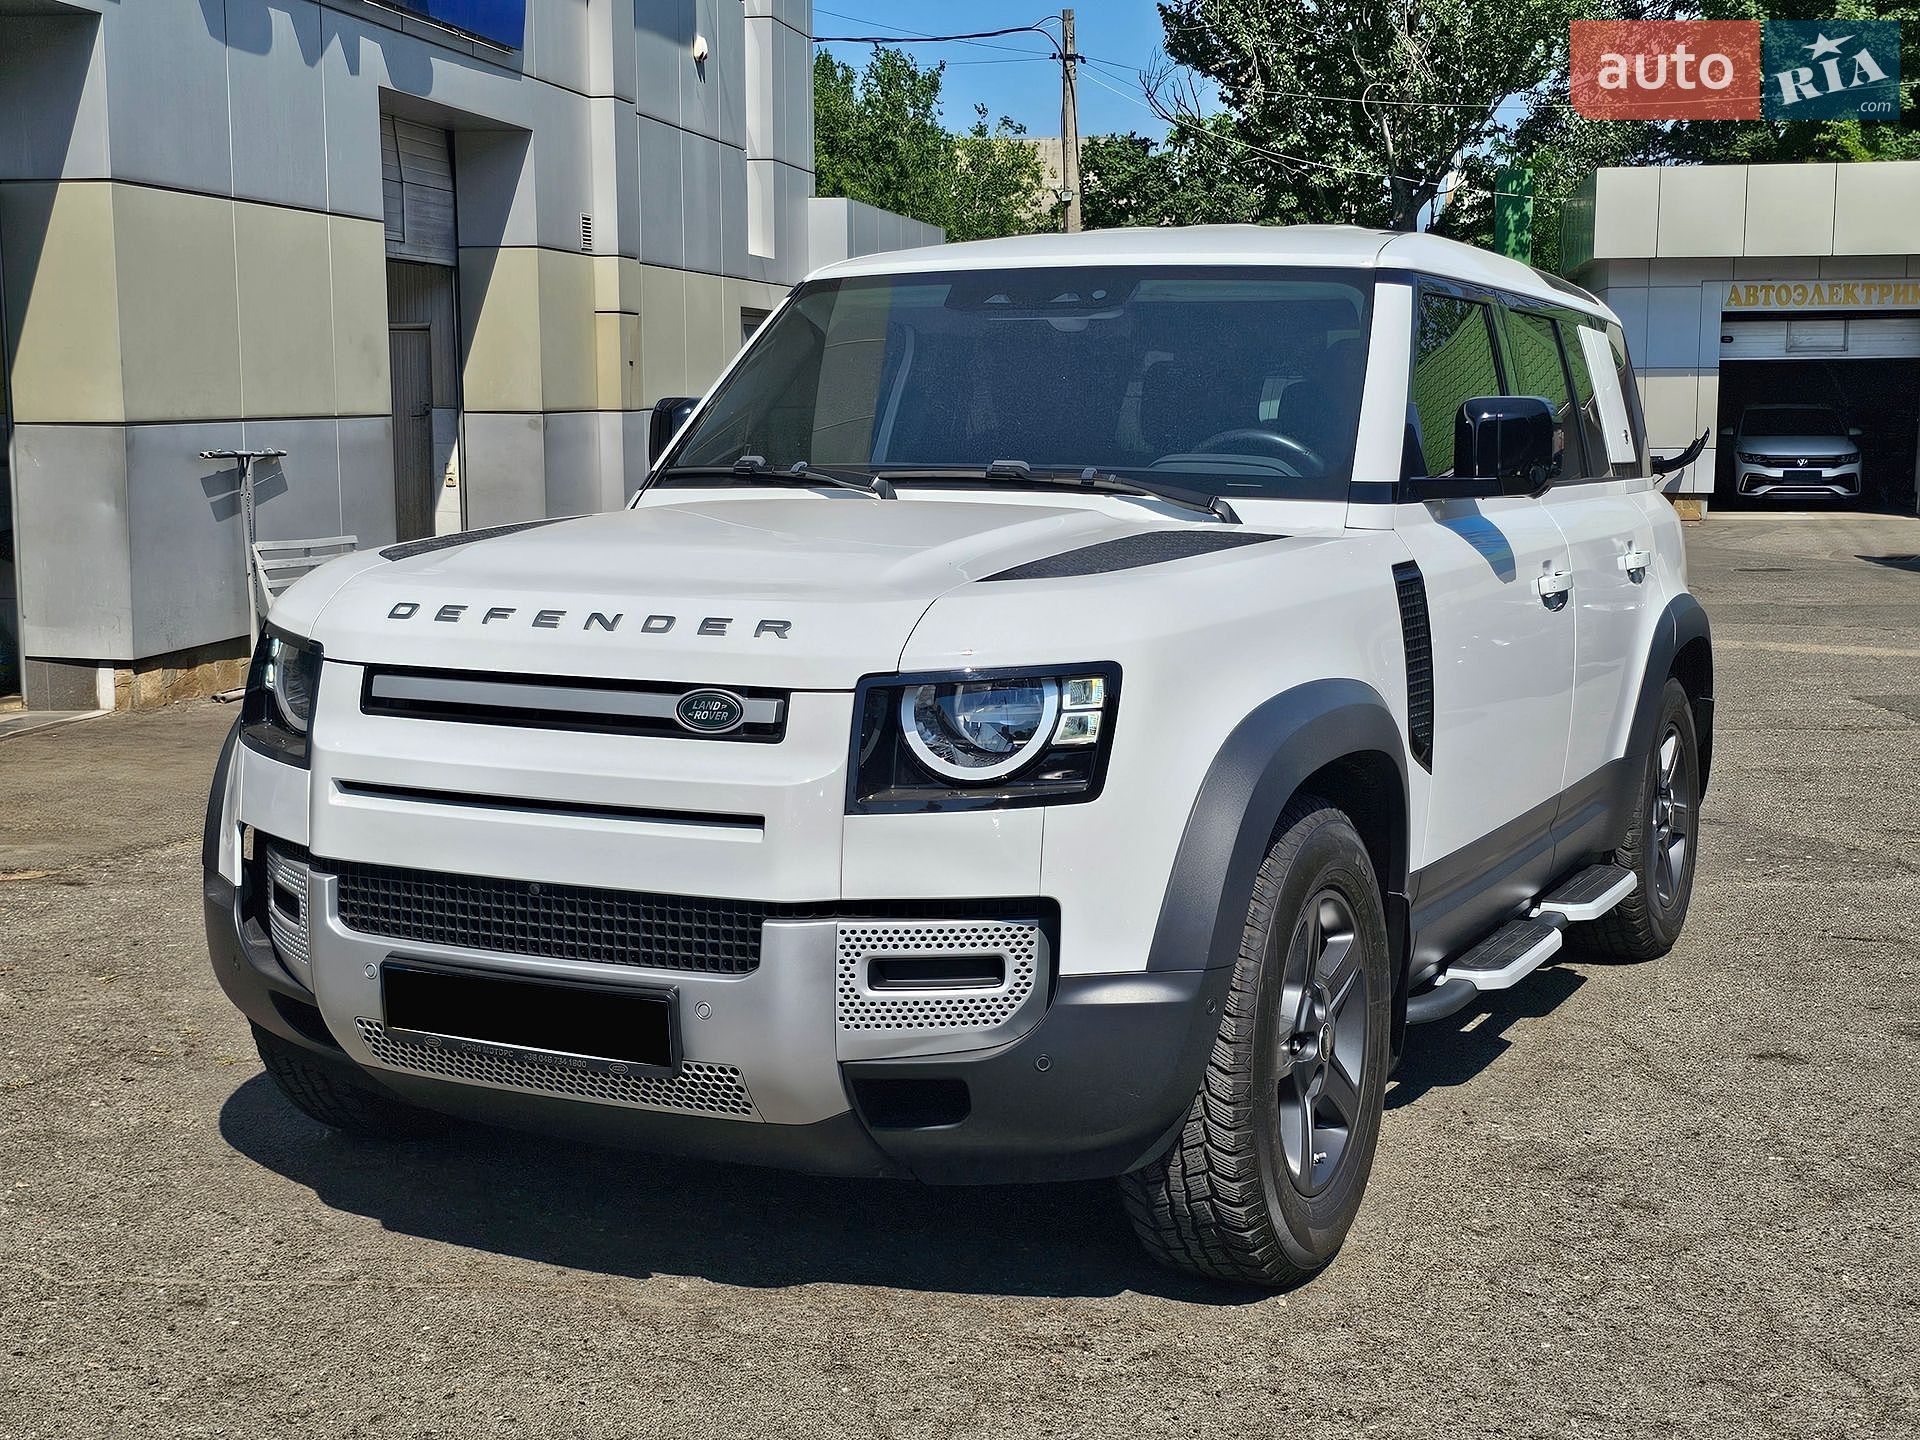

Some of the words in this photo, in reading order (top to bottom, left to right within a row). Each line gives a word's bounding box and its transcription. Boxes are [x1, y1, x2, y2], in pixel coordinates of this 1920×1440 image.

[387, 602, 793, 640] DEFENDER
[692, 700, 721, 711] LAND
[693, 710, 729, 721] ROVER
